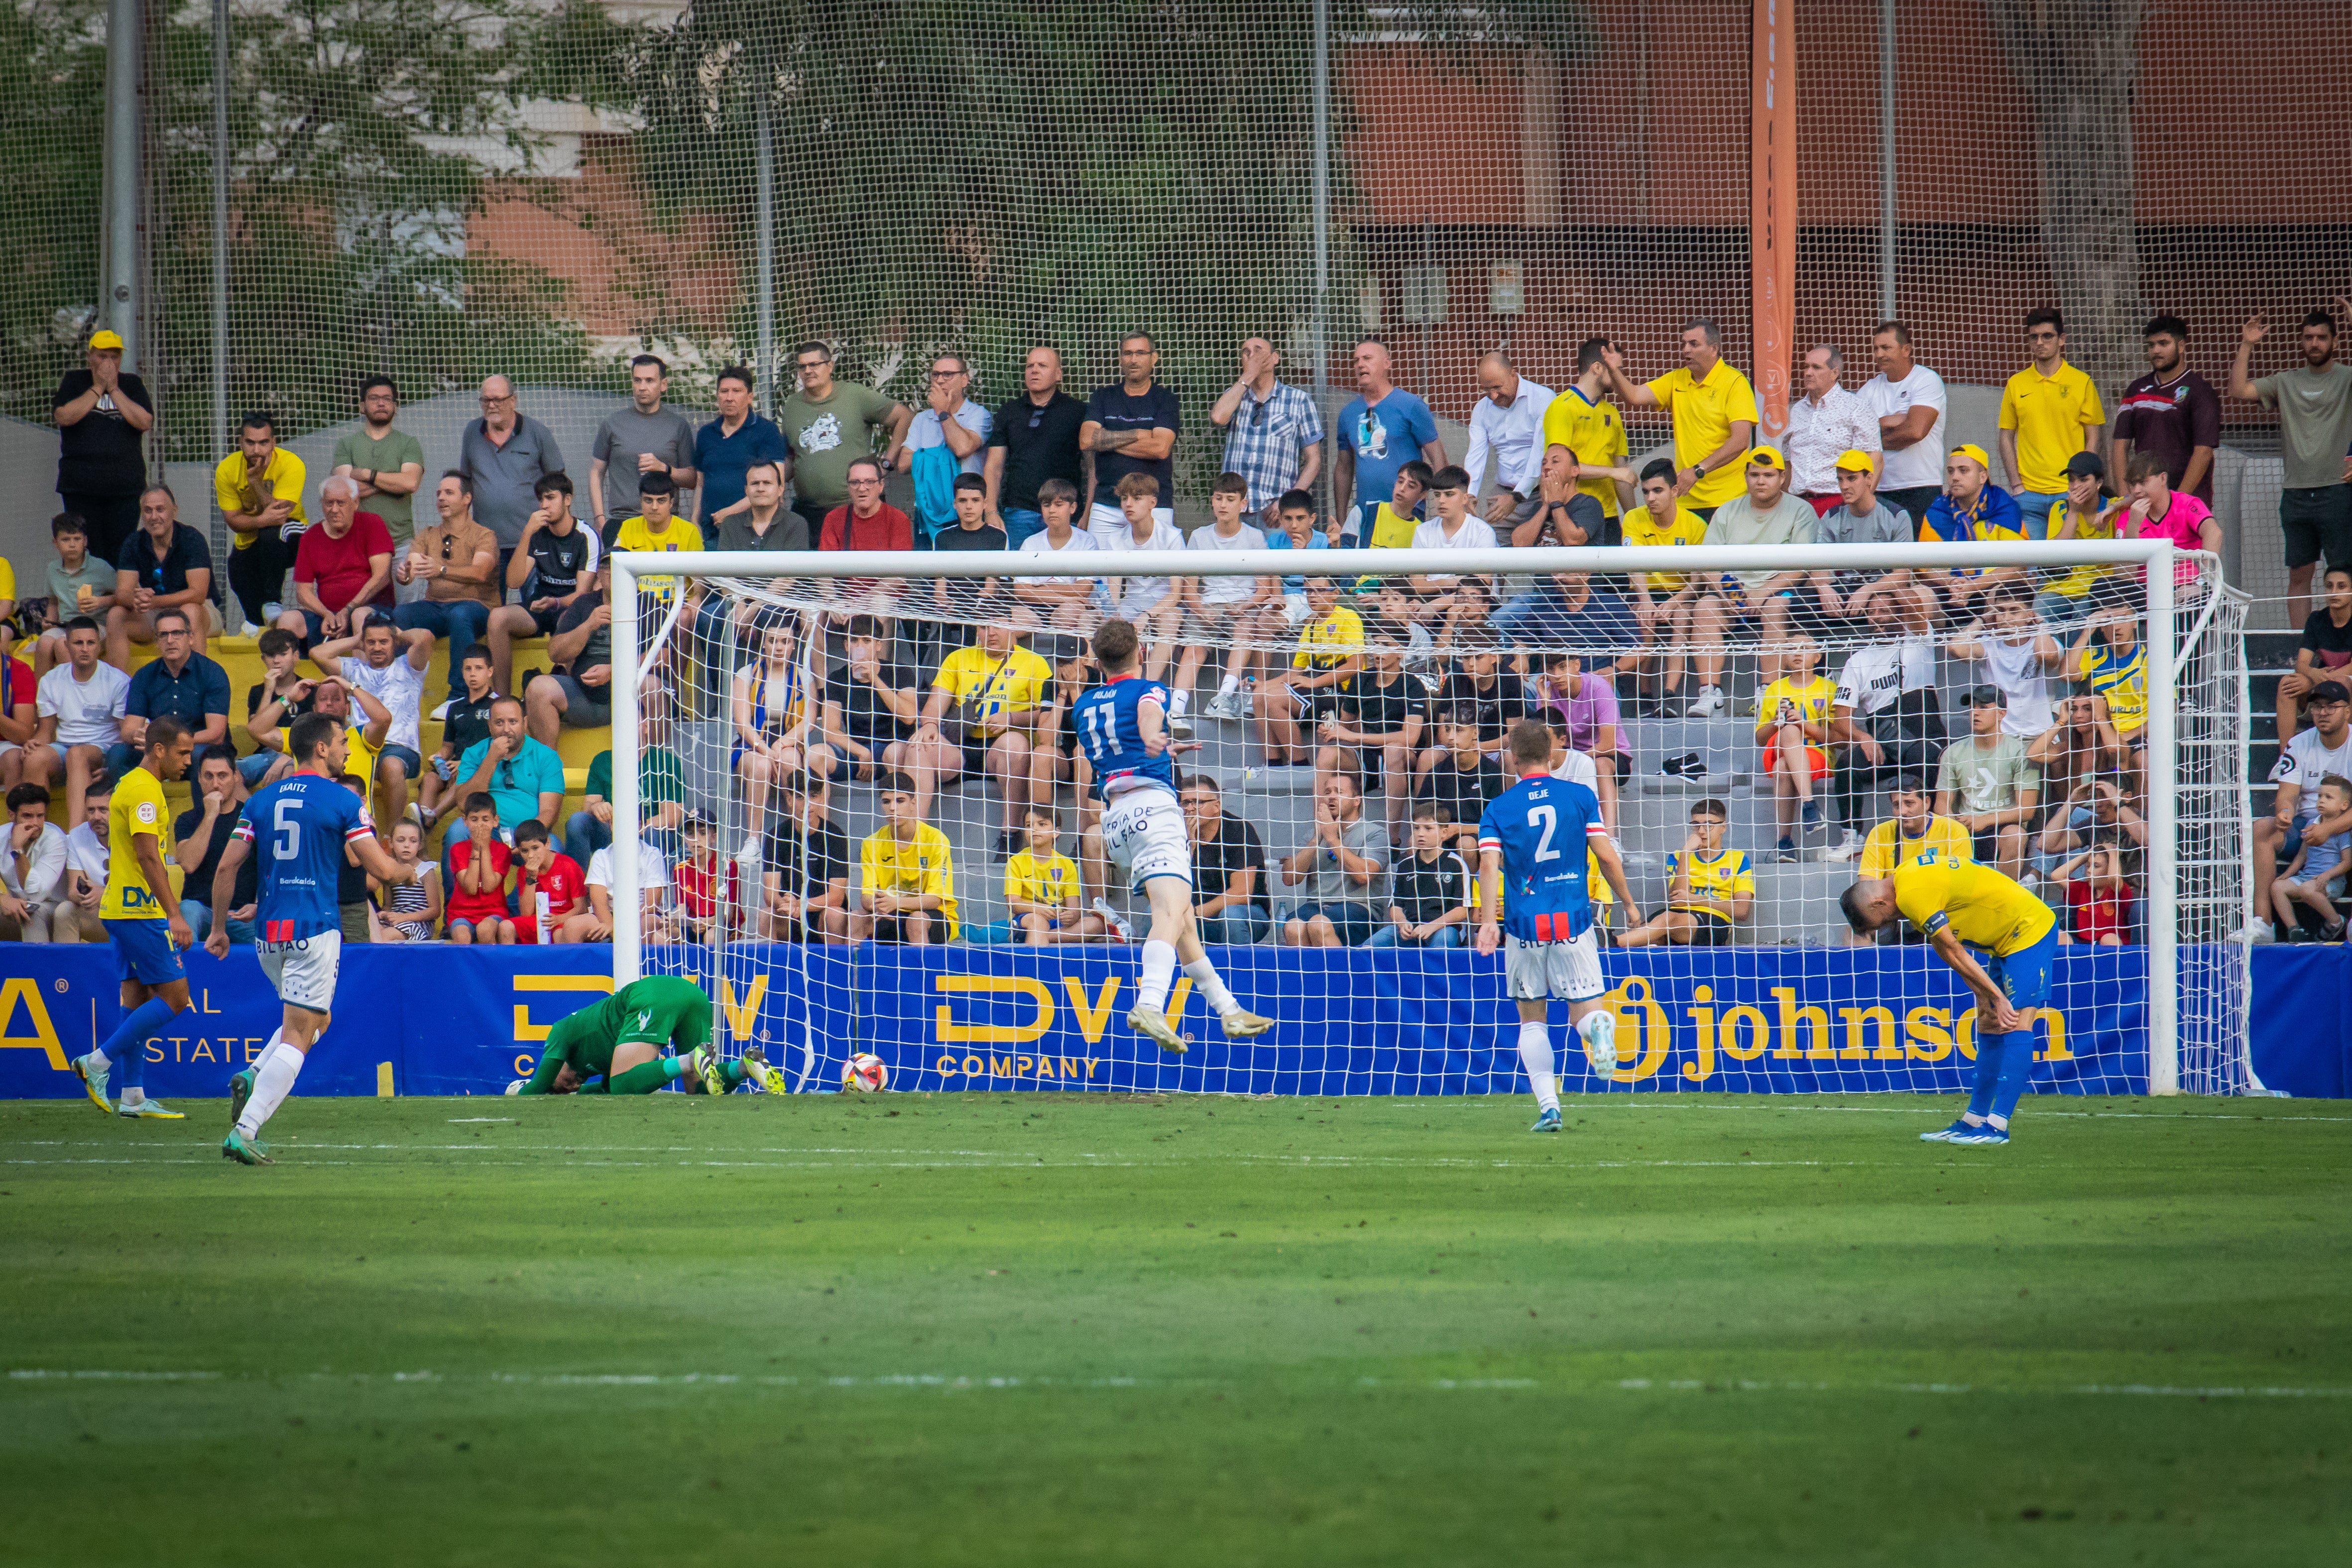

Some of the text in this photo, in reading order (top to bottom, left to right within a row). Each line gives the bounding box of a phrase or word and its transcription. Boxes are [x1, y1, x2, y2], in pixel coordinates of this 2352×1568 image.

[1871, 672, 1898, 690] PUM
[1083, 702, 1123, 761] 11
[279, 783, 308, 793] EKAITZ
[1134, 807, 1153, 818] DE
[273, 799, 303, 860] 5
[1527, 805, 1560, 863] 2
[122, 886, 157, 908] DM
[145, 1037, 263, 1063] STATE
[936, 1055, 1100, 1079] COMPANY
